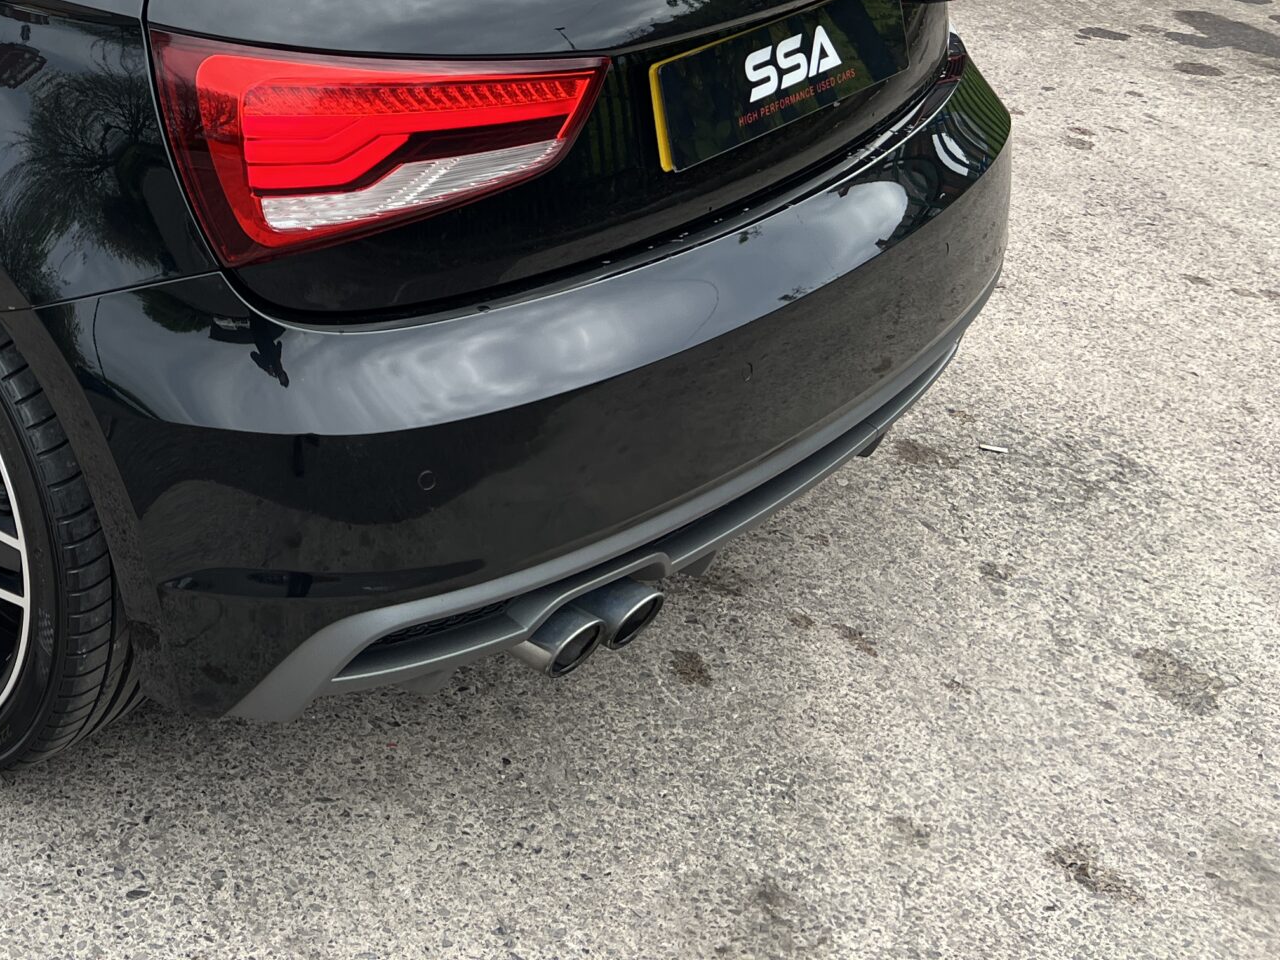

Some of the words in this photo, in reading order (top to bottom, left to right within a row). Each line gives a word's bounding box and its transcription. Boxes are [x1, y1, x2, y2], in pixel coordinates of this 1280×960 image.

[738, 108, 759, 127] HIGH
[760, 85, 816, 118] PERFORMANCE
[816, 76, 836, 93] USED
[837, 68, 856, 84] CARS
[744, 25, 842, 103] SSA
